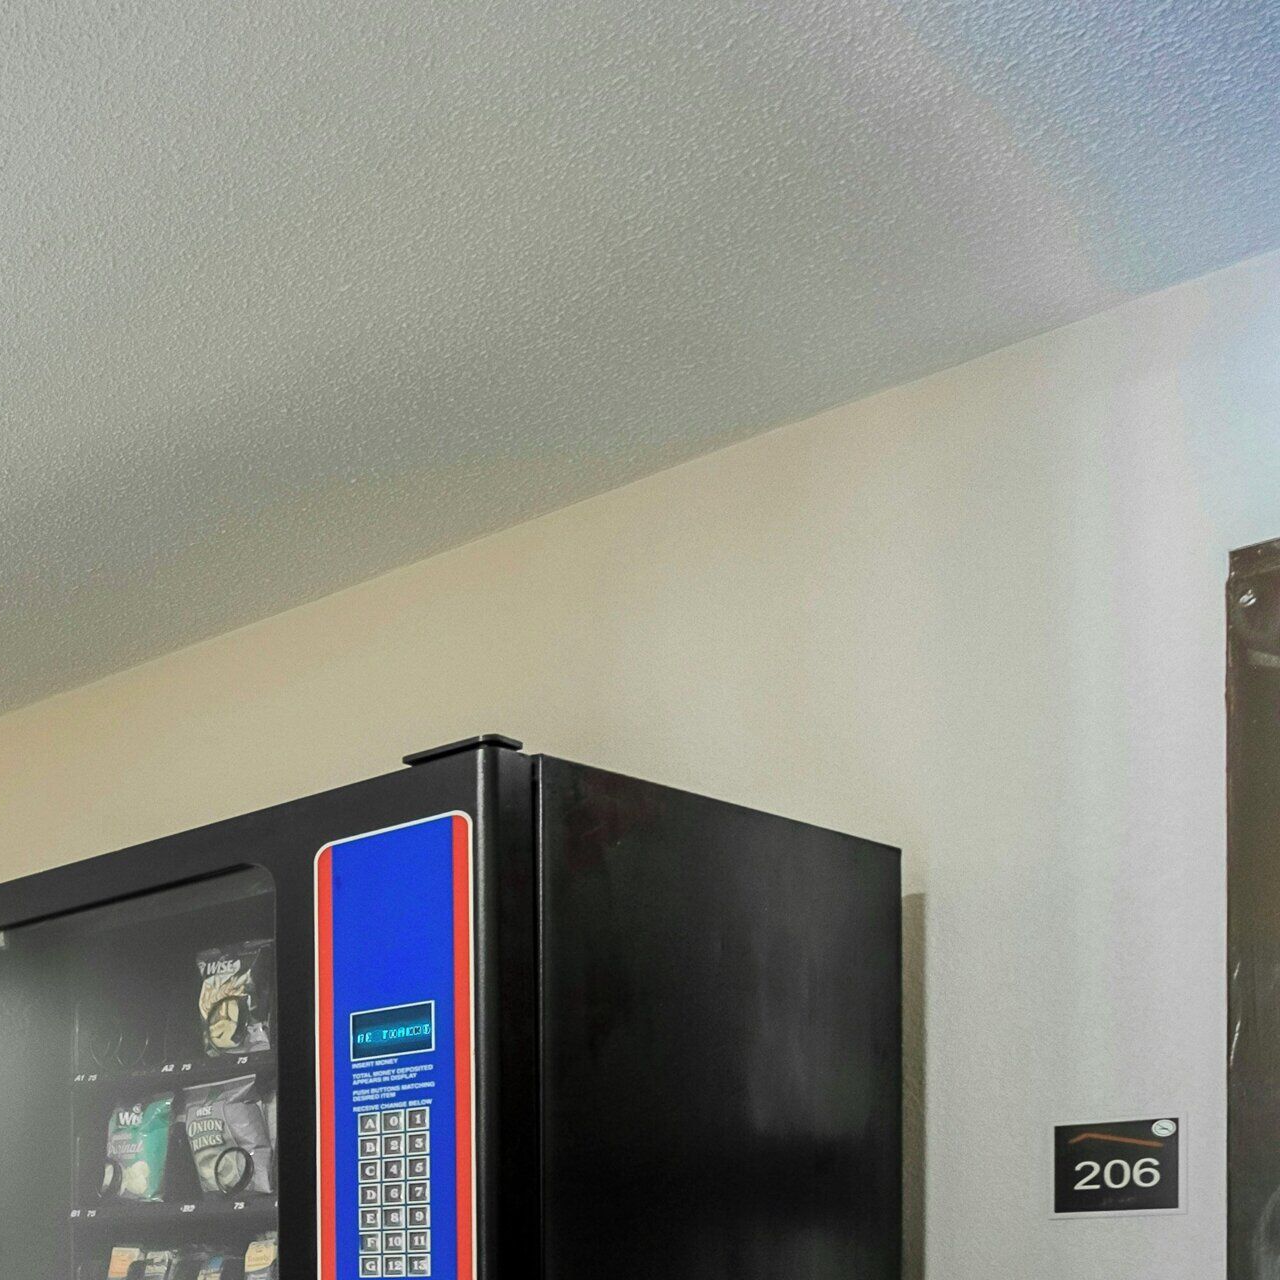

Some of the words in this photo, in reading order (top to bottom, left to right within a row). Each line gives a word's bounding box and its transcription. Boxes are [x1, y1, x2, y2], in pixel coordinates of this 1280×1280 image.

[352, 1061, 374, 1069] INSERT
[375, 1058, 398, 1066] MONEY
[373, 1069, 395, 1077] MONEY
[396, 1064, 434, 1074] DEPOSITED
[352, 1077, 381, 1085] APPEARS
[390, 1072, 417, 1080] DISPLAY
[370, 1085, 400, 1094] BUTTONS
[401, 1081, 435, 1090] MATCHING
[352, 1104, 380, 1112] RECEIVE
[380, 1101, 407, 1109] CHANGE
[408, 1098, 433, 1106] BELOW
[365, 1119, 375, 1129] A
[389, 1116, 398, 1126] 0
[415, 1114, 421, 1124] 1
[192, 1134, 223, 1151] RINGS
[366, 1142, 375, 1152] B
[390, 1140, 399, 1150] 2
[415, 1138, 423, 1148] 3
[365, 1166, 375, 1176] C
[390, 1165, 397, 1174] 4
[415, 1162, 424, 1172] 5
[1074, 1157, 1161, 1190] 206
[366, 1189, 376, 1200] D
[390, 1188, 399, 1198] 6
[415, 1187, 423, 1197] 7
[366, 1213, 376, 1223] E
[390, 1212, 399, 1222] 8
[415, 1211, 424, 1221] 9
[367, 1237, 376, 1248] F
[388, 1237, 401, 1247] 10
[414, 1235, 425, 1246] 11
[365, 1261, 376, 1271] G
[388, 1261, 401, 1271] 12
